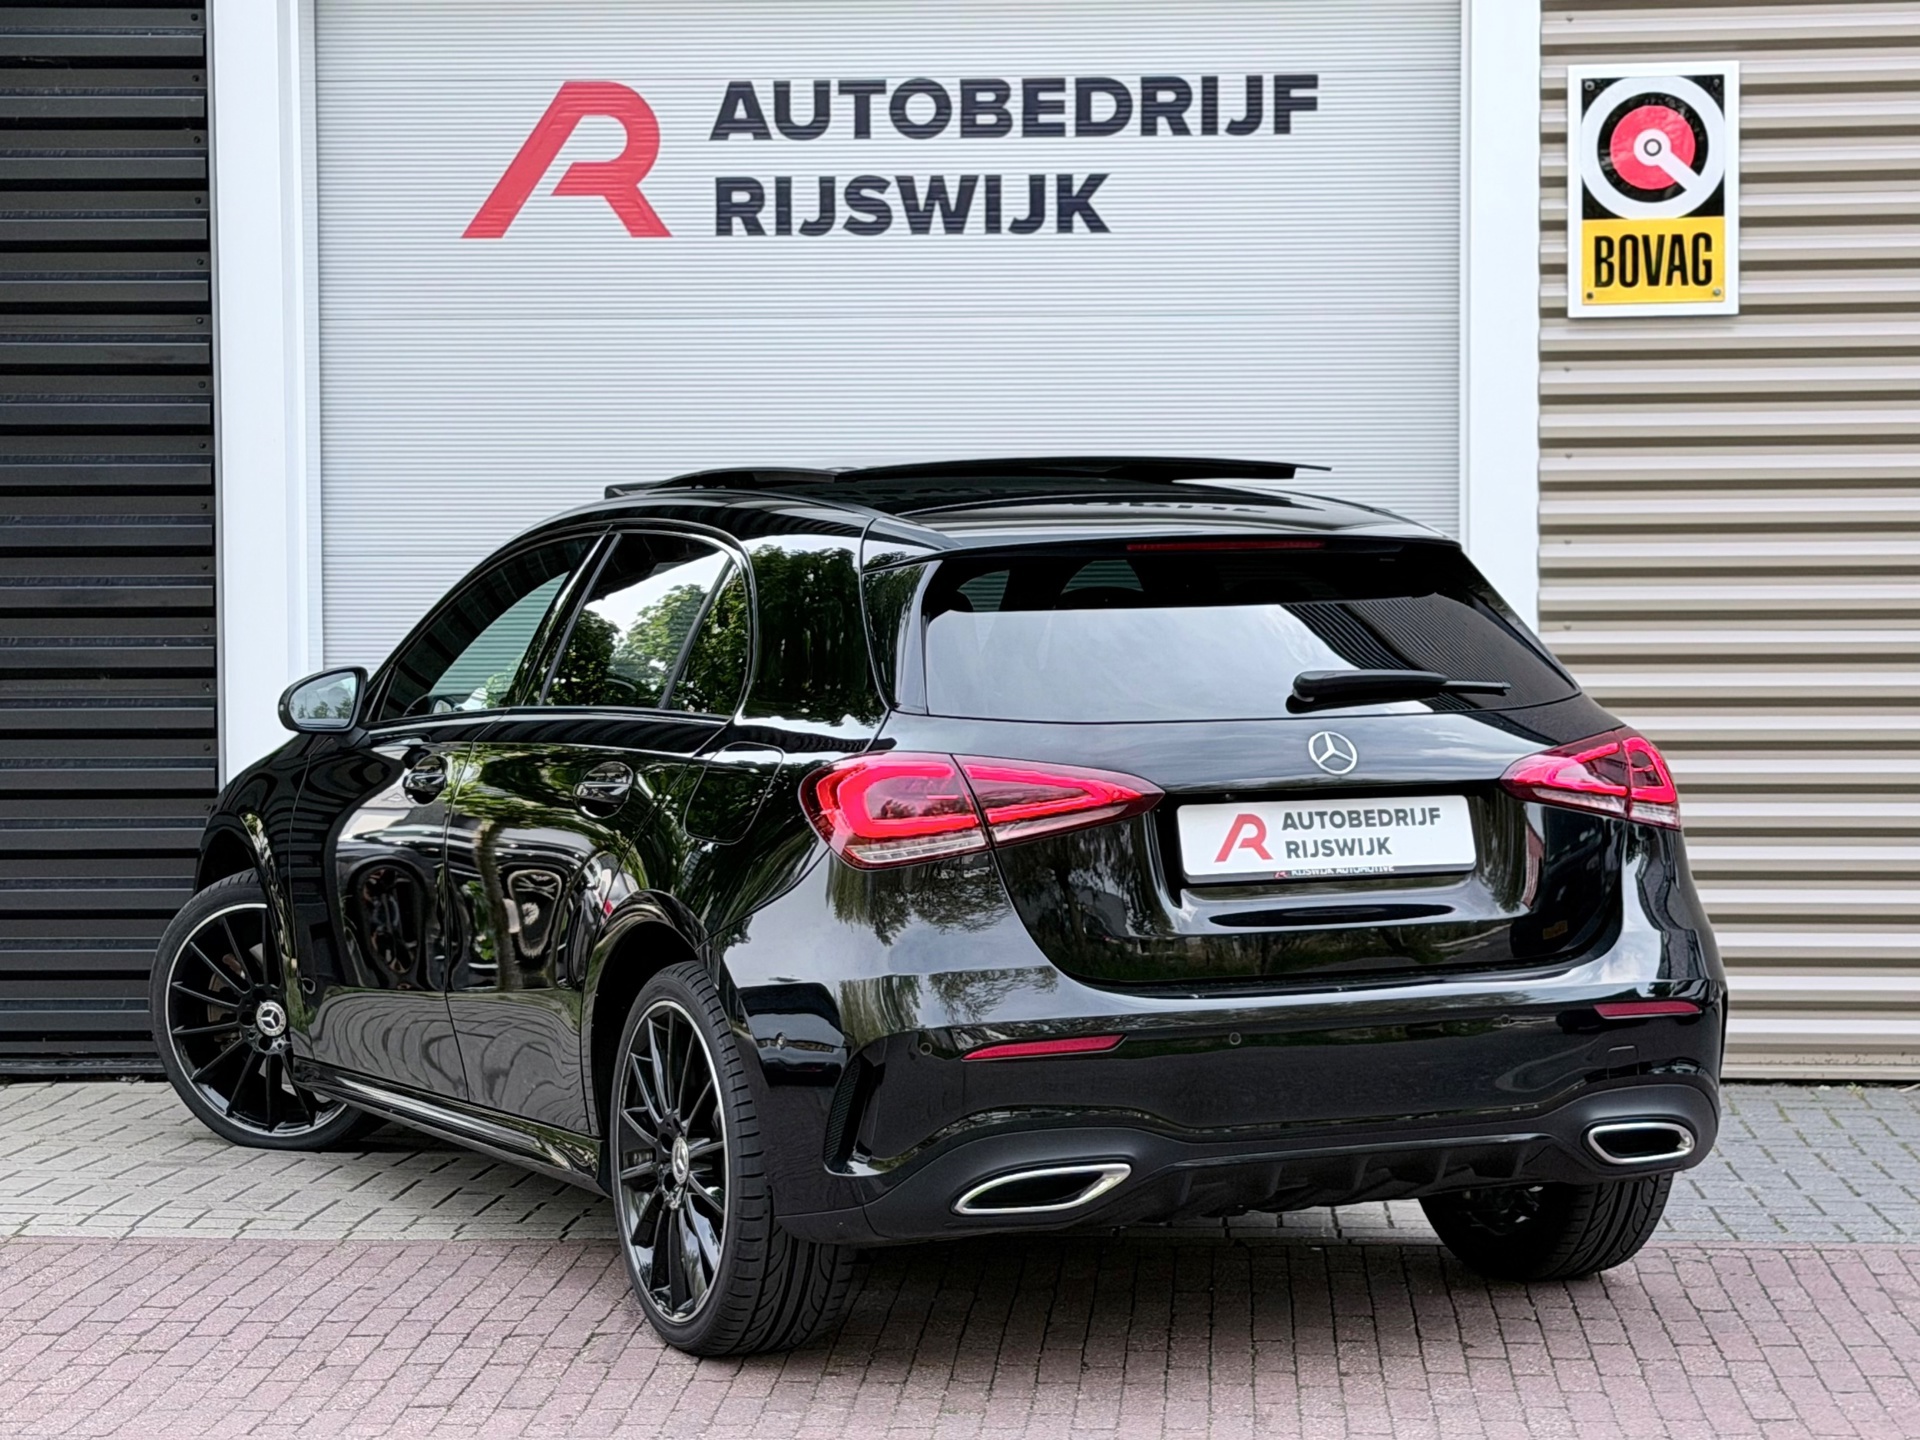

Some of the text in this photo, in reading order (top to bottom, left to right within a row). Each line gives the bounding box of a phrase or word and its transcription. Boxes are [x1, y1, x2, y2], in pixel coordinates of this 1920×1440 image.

[709, 74, 1319, 141] AUTOBEDRIJF
[714, 173, 1110, 237] RIJSWIJK
[1594, 232, 1713, 289] BOVAG
[1281, 807, 1441, 831] AUTOBEDRIJF
[1285, 836, 1393, 859] RIJSWIJK
